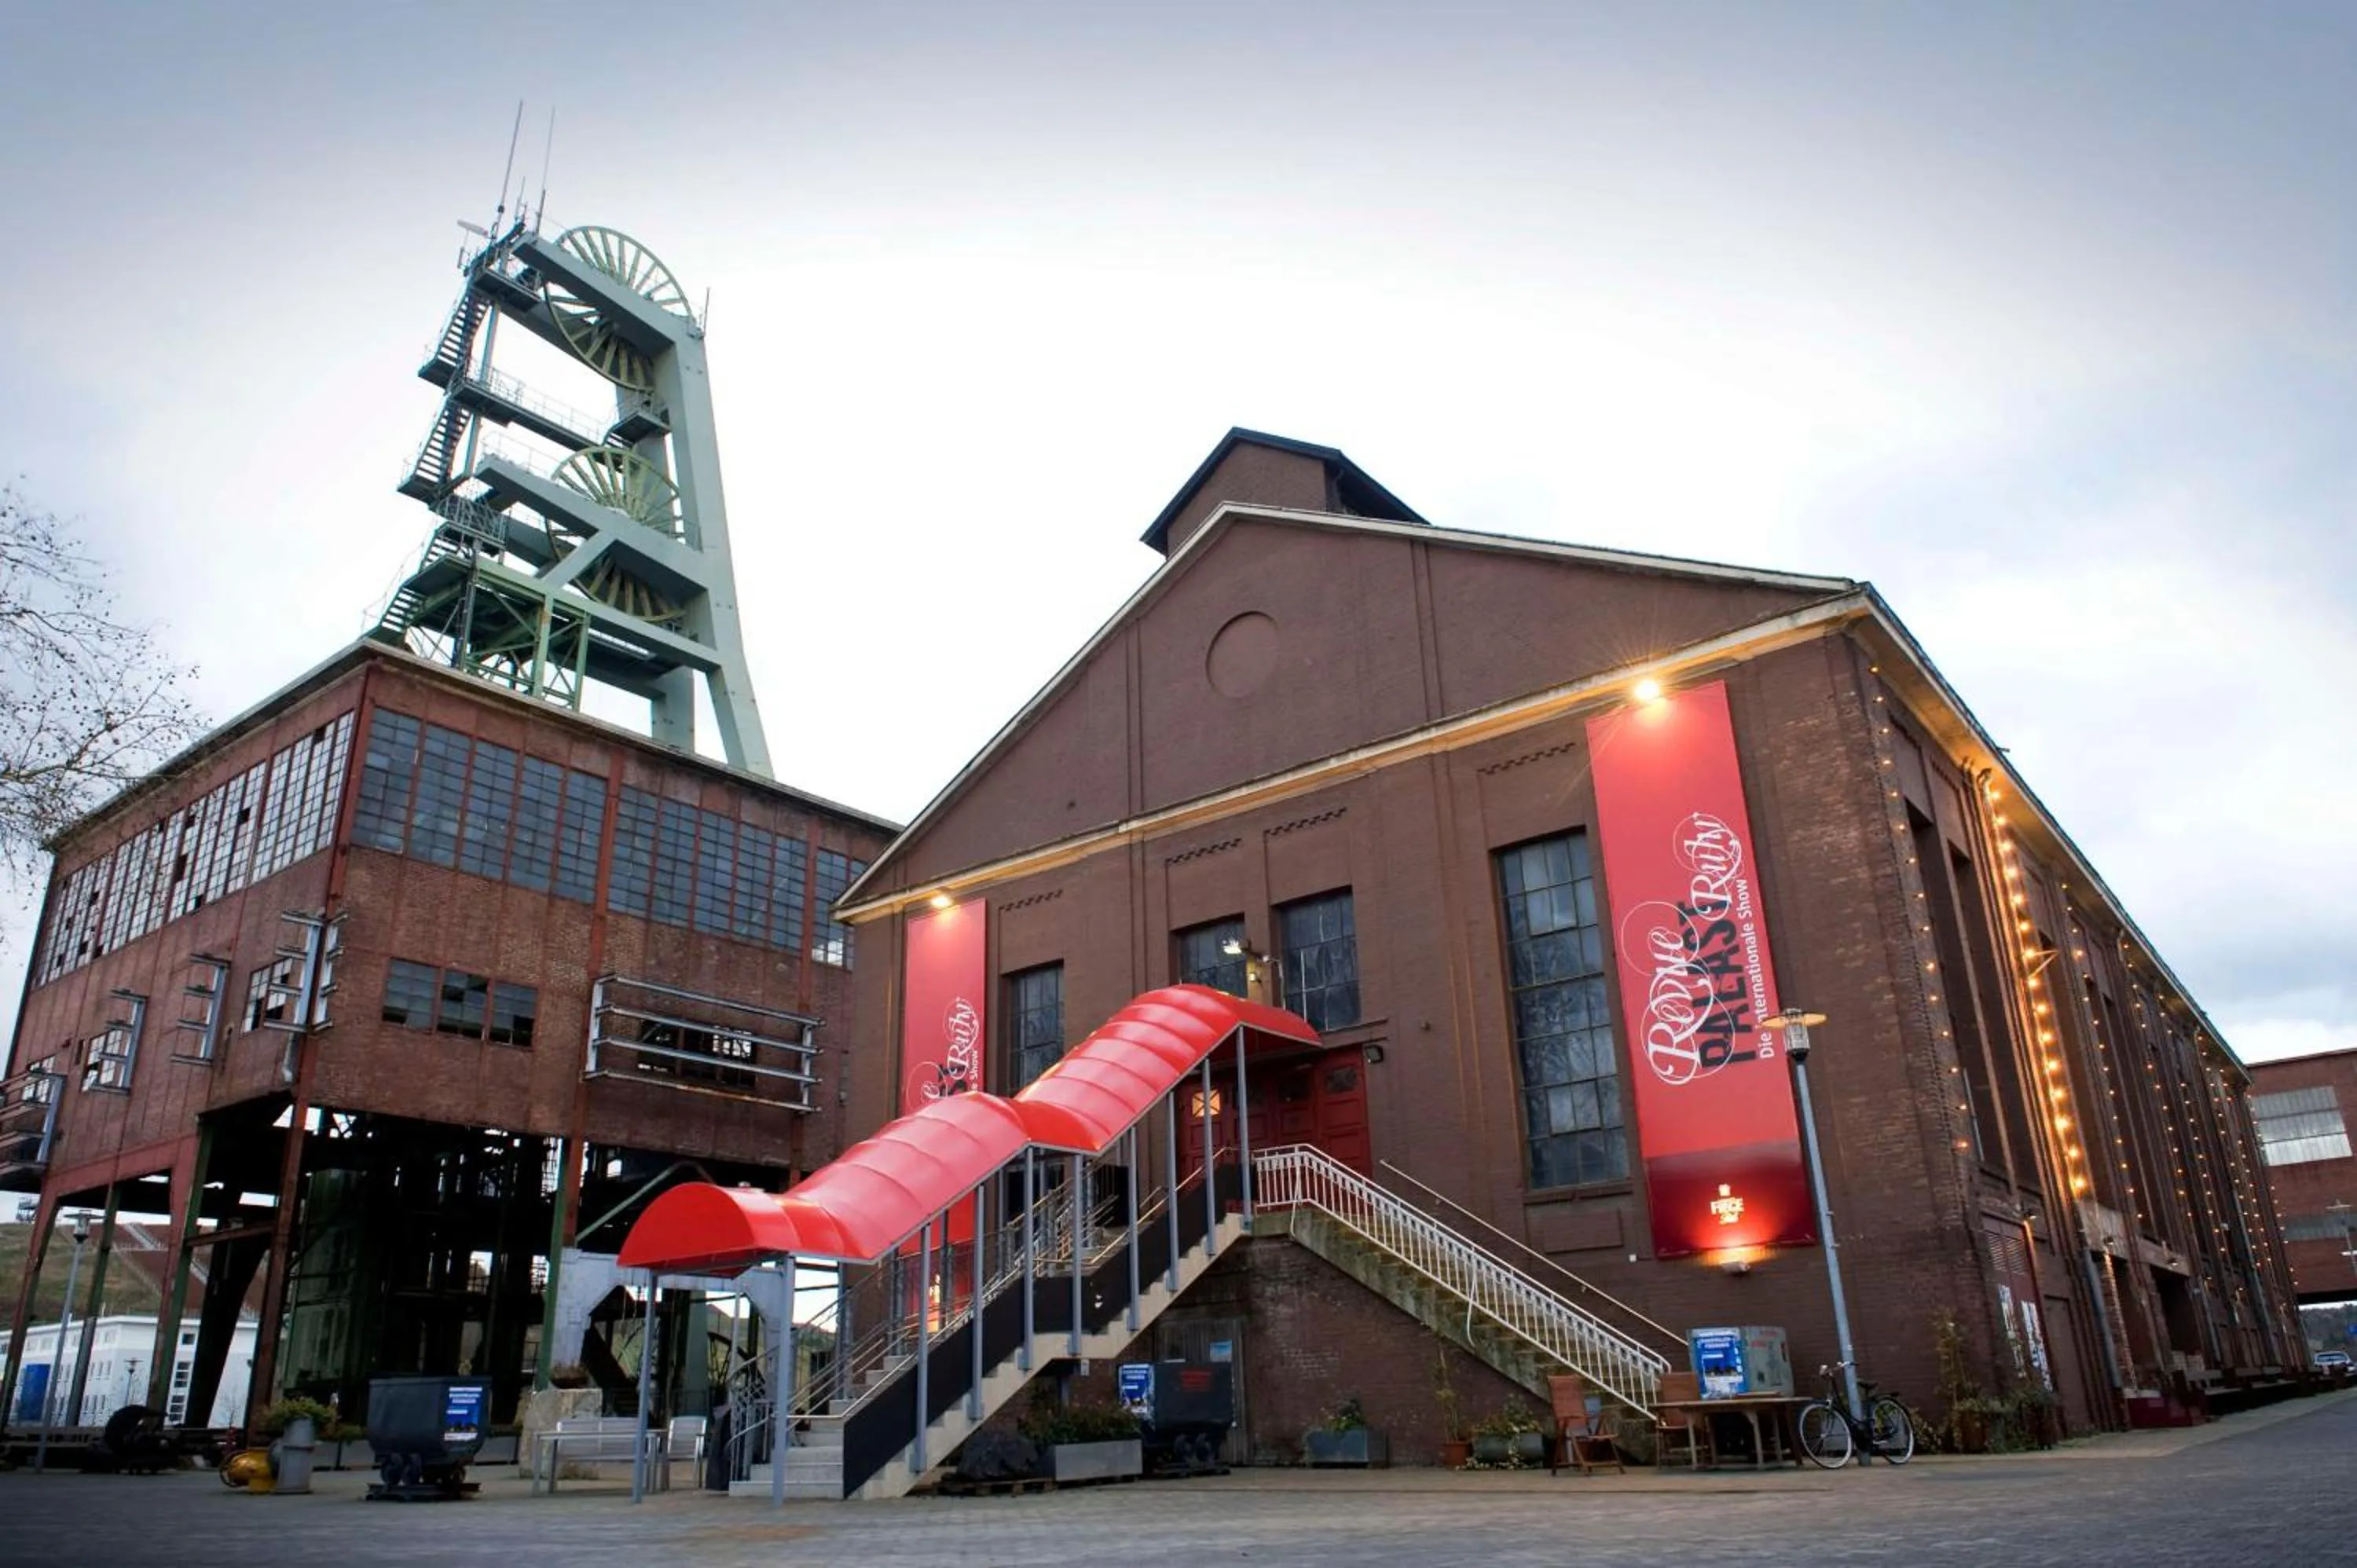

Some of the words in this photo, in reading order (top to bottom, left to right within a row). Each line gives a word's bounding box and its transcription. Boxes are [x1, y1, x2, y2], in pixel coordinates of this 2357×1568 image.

[1673, 811, 1743, 921] Ruhr
[1735, 878, 1754, 918] Show
[1677, 899, 1757, 1070] PALAST
[943, 995, 980, 1080] Ruhr
[1754, 1033, 1776, 1059] Die
